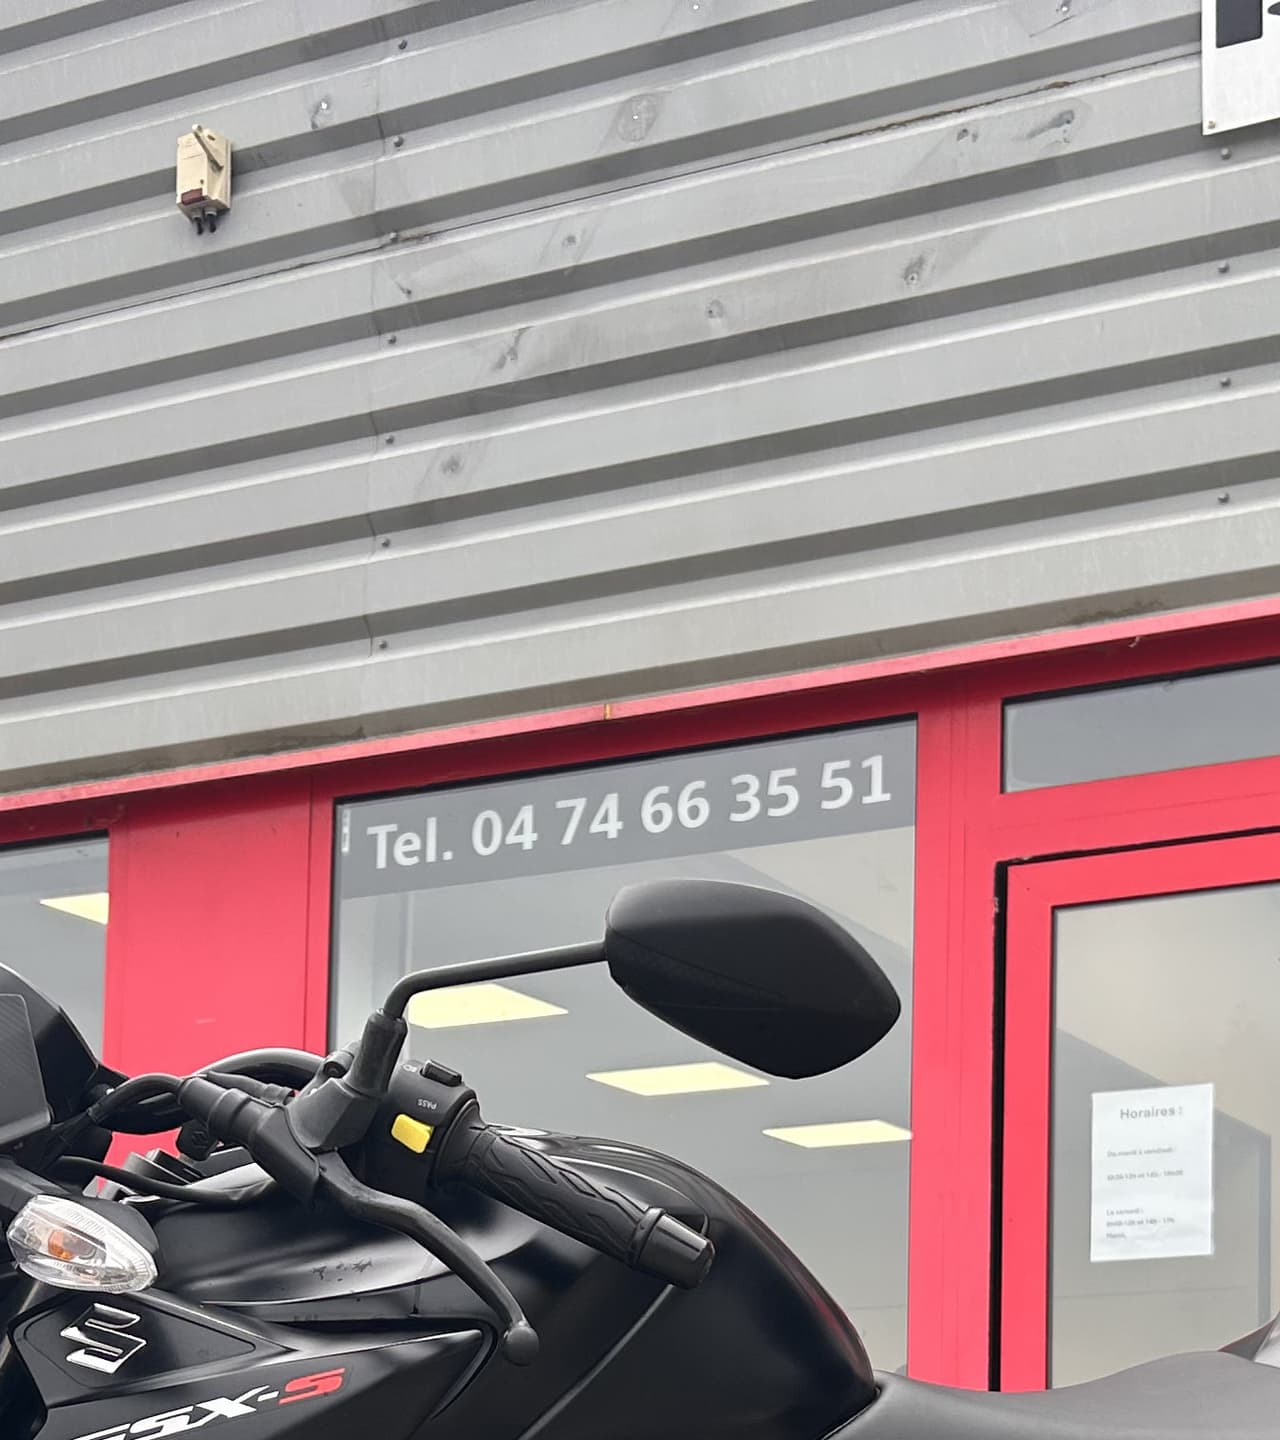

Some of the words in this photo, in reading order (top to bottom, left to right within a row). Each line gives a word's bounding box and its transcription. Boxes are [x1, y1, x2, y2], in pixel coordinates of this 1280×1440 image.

[366, 817, 454, 870] Tel.
[471, 803, 538, 856] 04
[554, 793, 624, 846] 74
[641, 780, 710, 834] 66
[728, 768, 800, 822] 35
[820, 754, 892, 810] 51
